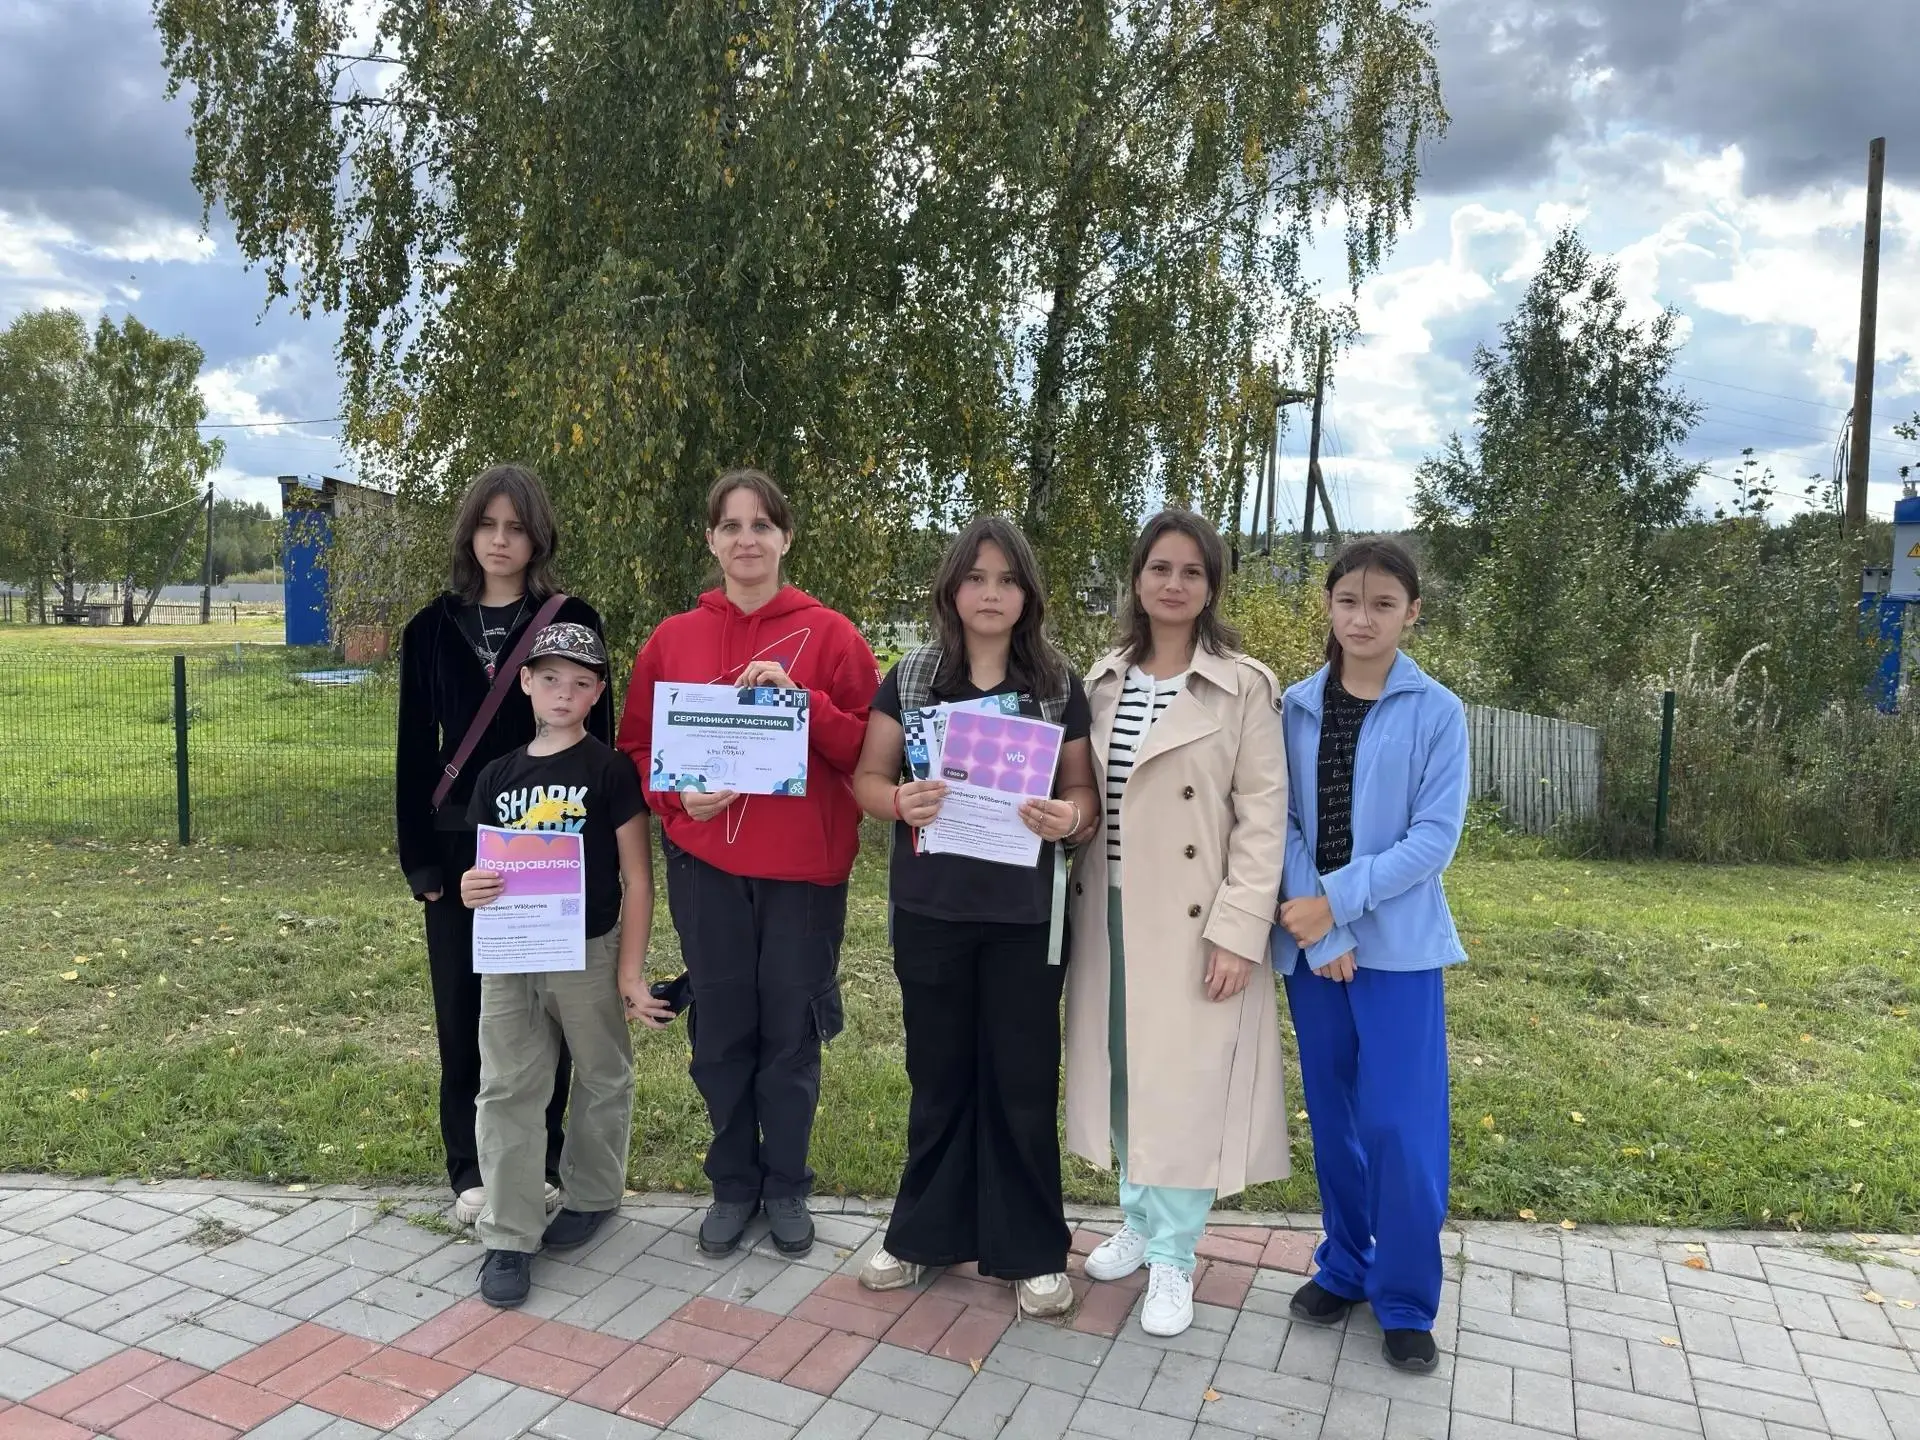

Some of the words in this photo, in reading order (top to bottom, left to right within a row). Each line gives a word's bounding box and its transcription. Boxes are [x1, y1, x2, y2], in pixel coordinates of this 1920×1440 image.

[673, 714, 734, 724] СЕРТИФИКАТ
[736, 717, 789, 728] УЧАСТНИКА
[1006, 751, 1025, 763] wb
[495, 785, 588, 823] SHARK
